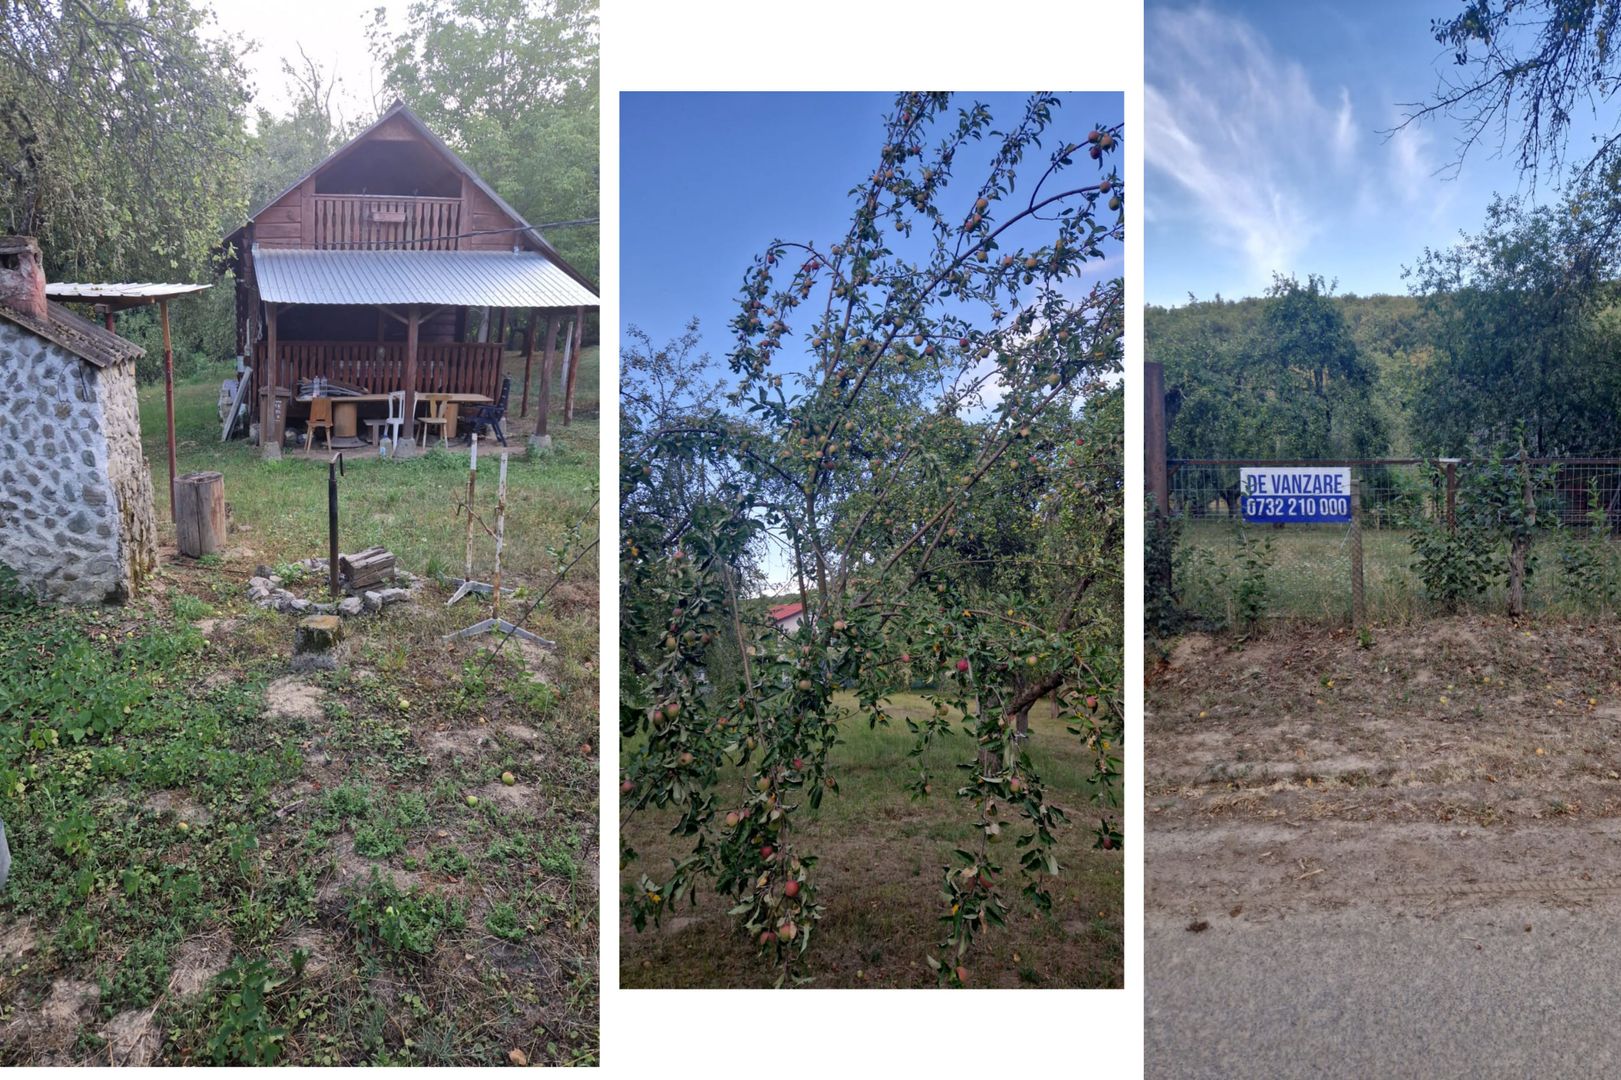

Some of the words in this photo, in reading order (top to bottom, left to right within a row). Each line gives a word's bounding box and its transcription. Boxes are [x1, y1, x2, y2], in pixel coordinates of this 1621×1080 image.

[1247, 474, 1267, 494] DE
[1271, 474, 1343, 494] VANZARE
[1247, 498, 1284, 516] 0732
[1288, 498, 1316, 516] 210
[1319, 498, 1347, 516] 000
